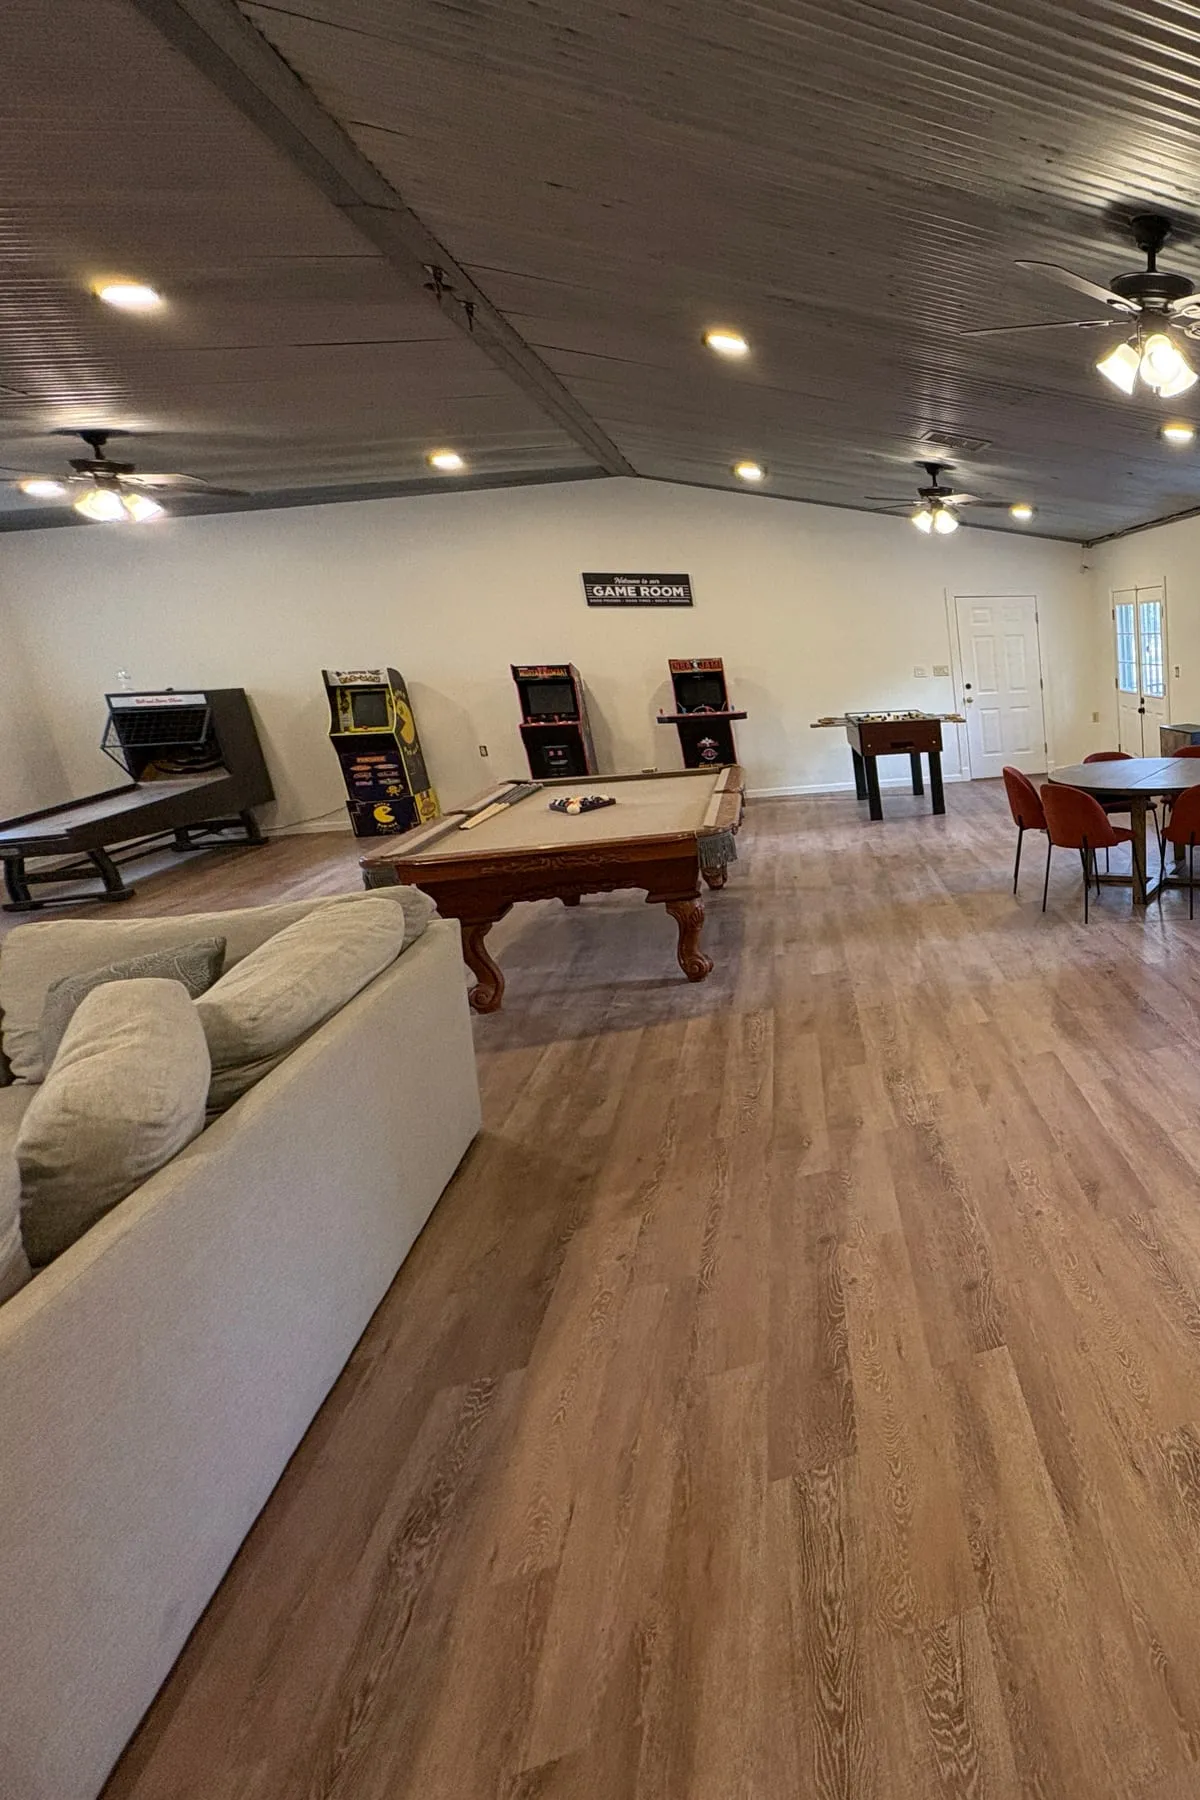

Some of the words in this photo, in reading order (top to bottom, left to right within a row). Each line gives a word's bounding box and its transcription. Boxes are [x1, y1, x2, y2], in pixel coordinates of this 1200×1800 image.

[592, 586, 637, 597] GAME
[639, 586, 685, 597] ROOM
[671, 661, 691, 671] NBA
